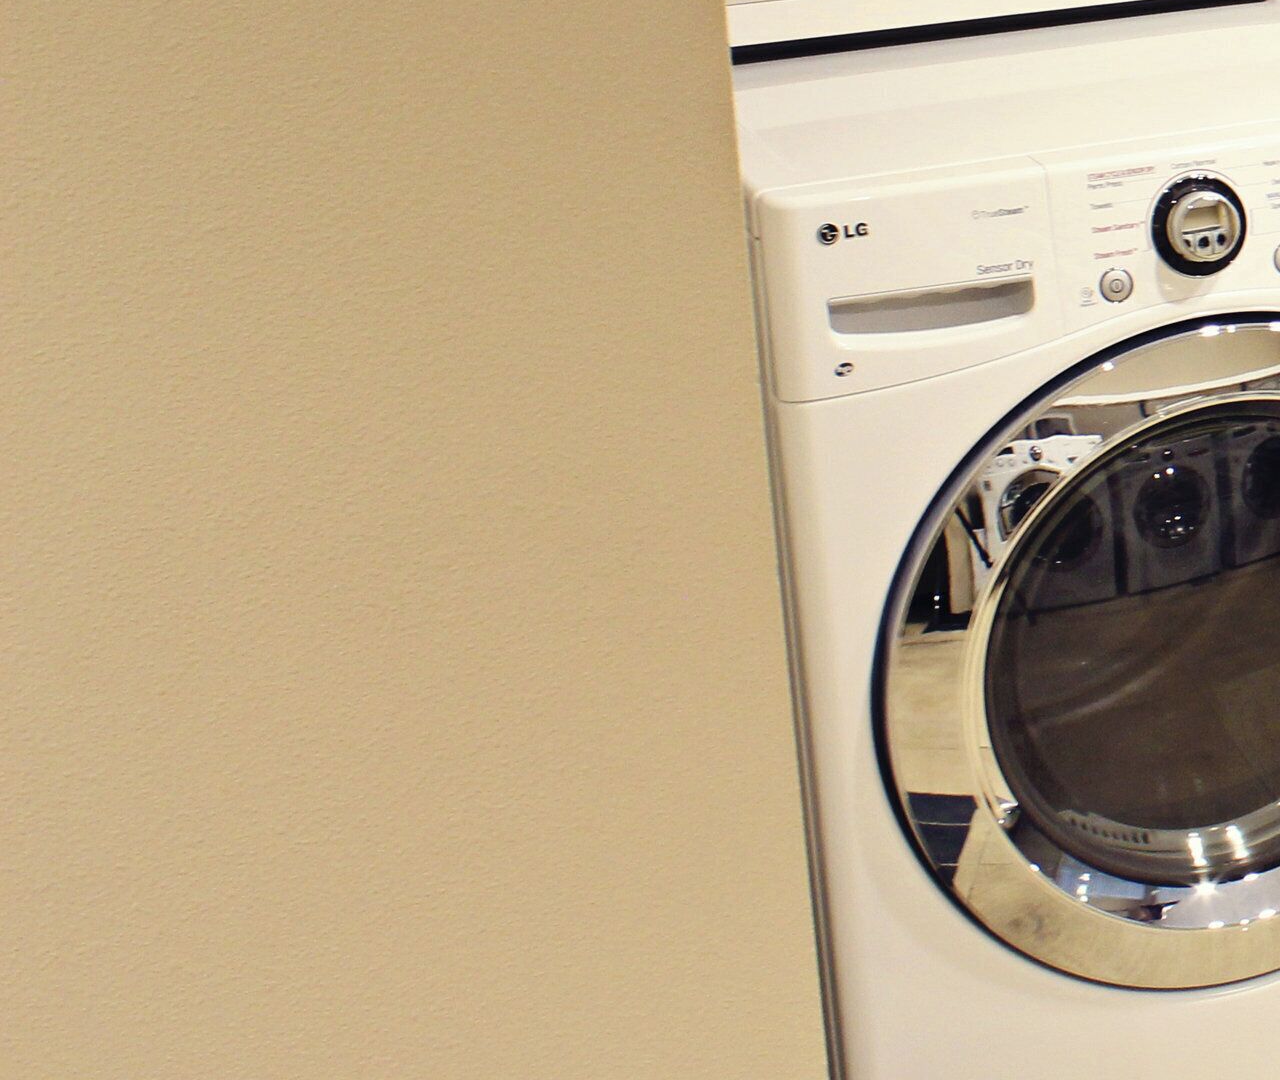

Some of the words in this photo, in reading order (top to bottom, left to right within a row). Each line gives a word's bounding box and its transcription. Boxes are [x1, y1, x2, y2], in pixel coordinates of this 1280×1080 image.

[844, 222, 869, 239] LG
[976, 262, 1013, 275] Sensor
[1015, 258, 1034, 272] Dry
